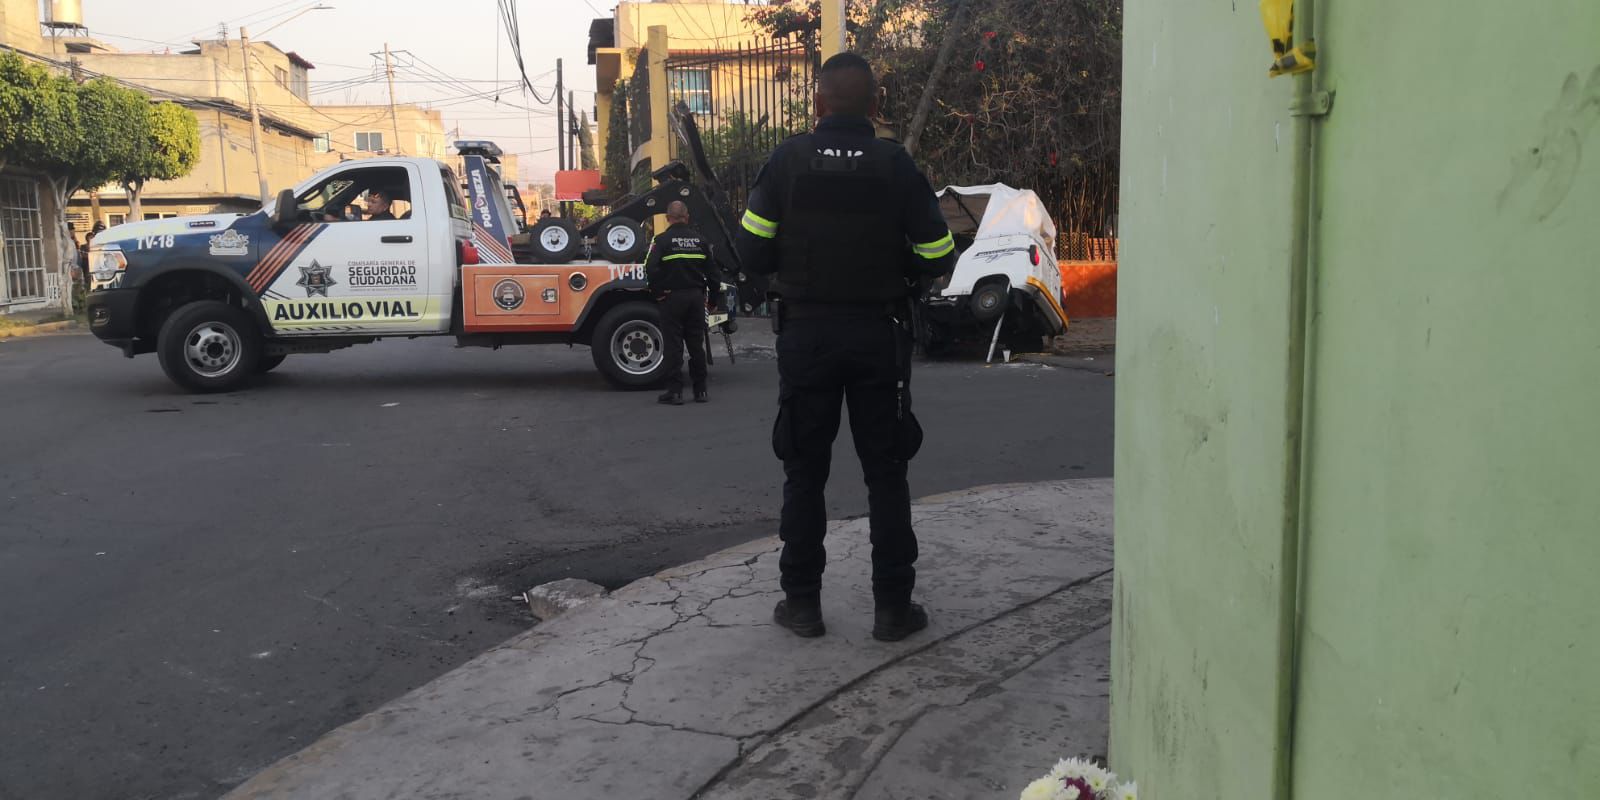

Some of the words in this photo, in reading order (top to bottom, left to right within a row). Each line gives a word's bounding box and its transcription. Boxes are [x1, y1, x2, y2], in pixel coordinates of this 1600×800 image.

[136, 234, 175, 250] TV-18
[348, 265, 416, 276] SEGURIDAD
[607, 264, 645, 280] TV-18
[349, 275, 417, 285] CIUDADANA
[274, 302, 363, 320] AUXILIO
[366, 301, 418, 317] VIAL
